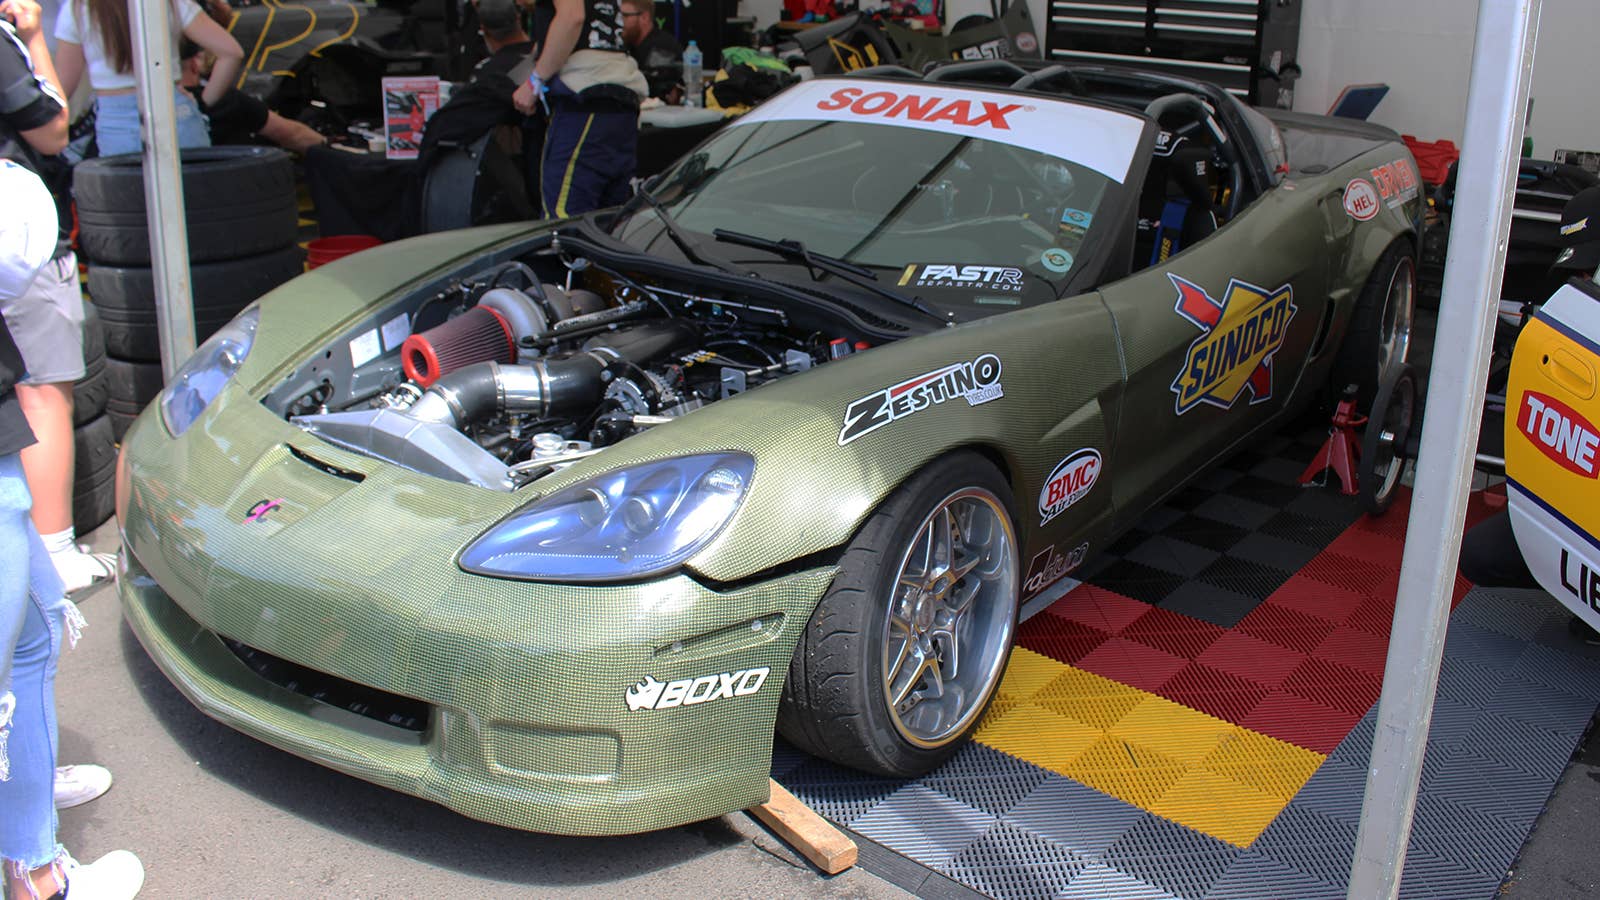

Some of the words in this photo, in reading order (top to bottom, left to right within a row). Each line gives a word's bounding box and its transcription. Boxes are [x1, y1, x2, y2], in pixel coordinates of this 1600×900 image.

[816, 87, 1023, 131] SONAX
[1353, 194, 1374, 213] HEL
[916, 280, 1022, 292] BEFASTR.COM
[1184, 297, 1288, 399] SUNOCO
[840, 354, 1001, 444] ZESTINO
[1527, 395, 1599, 474] TONE
[1045, 458, 1096, 508] BMC
[655, 666, 770, 710] BOXO
